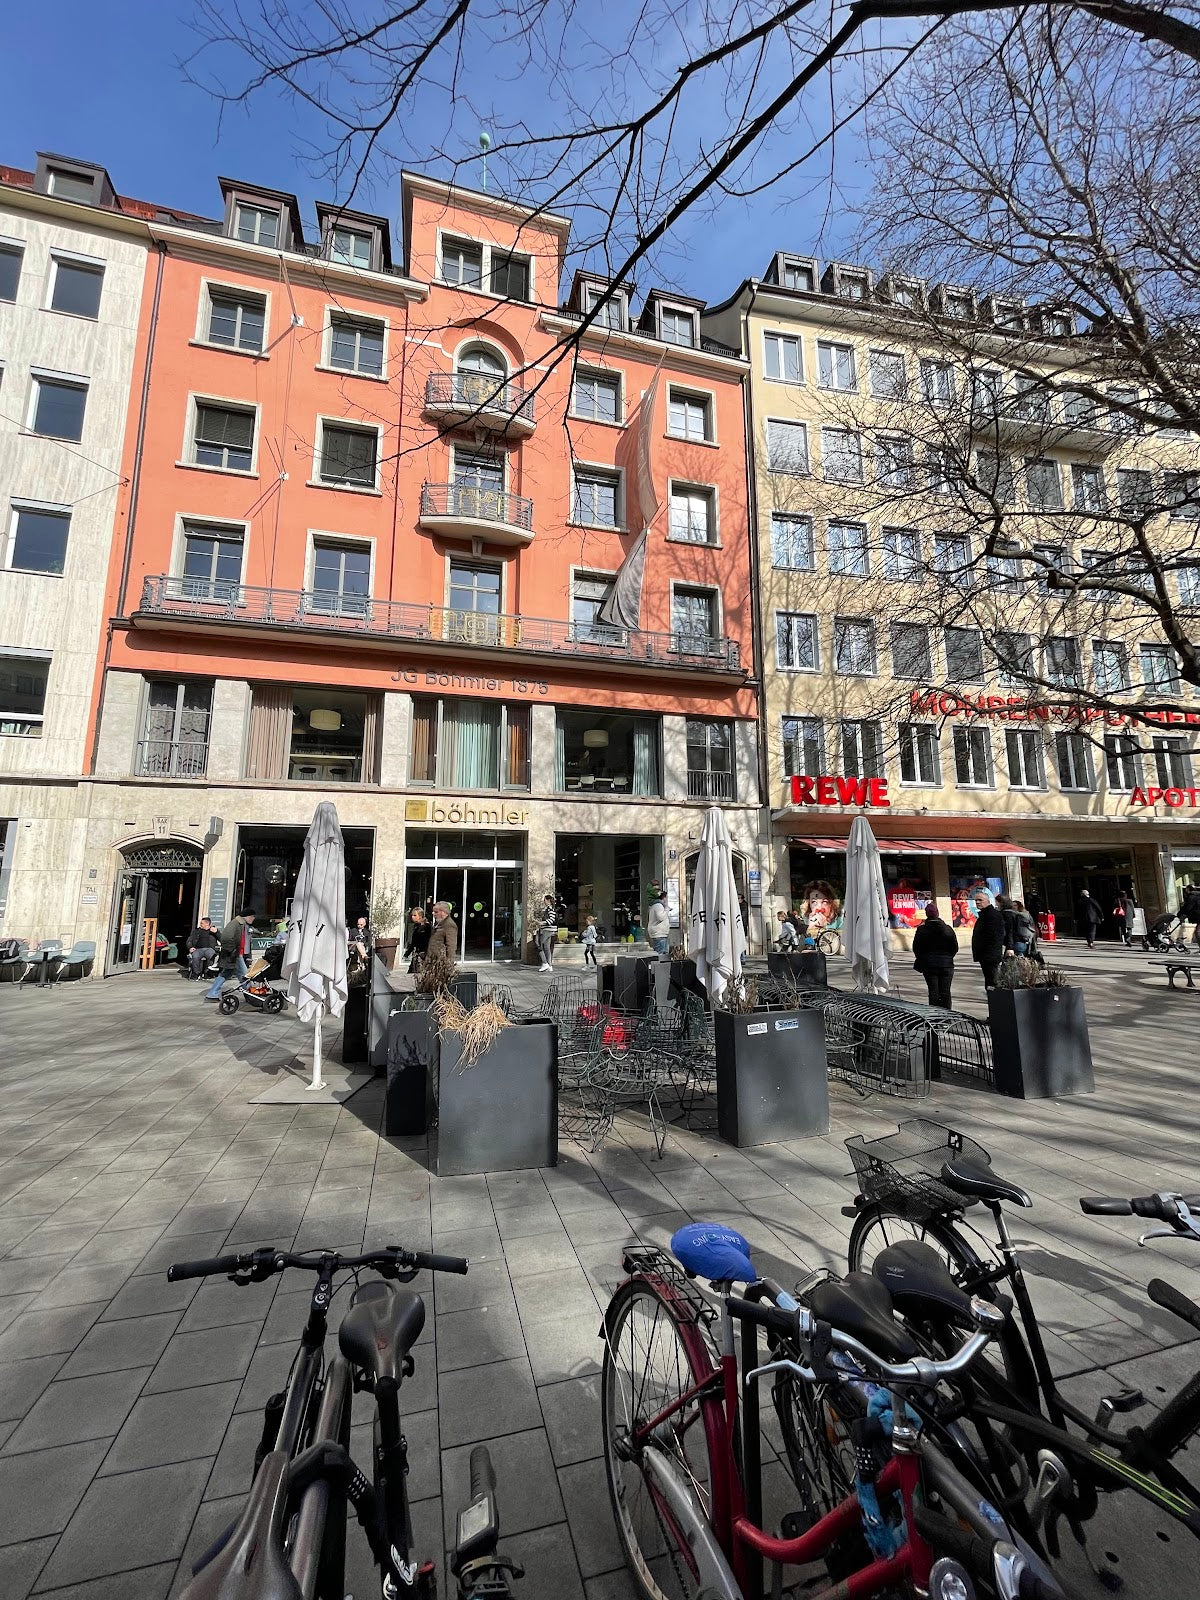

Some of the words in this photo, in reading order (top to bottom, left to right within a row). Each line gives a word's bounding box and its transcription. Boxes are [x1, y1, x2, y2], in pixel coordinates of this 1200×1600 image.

[391, 668, 418, 684] JG
[425, 668, 505, 690] Böhmler
[512, 677, 549, 695] 1875
[791, 776, 891, 807] REWE
[1130, 786, 1200, 808] APOT
[432, 801, 529, 825] böhmler
[892, 893, 915, 901] REWE
